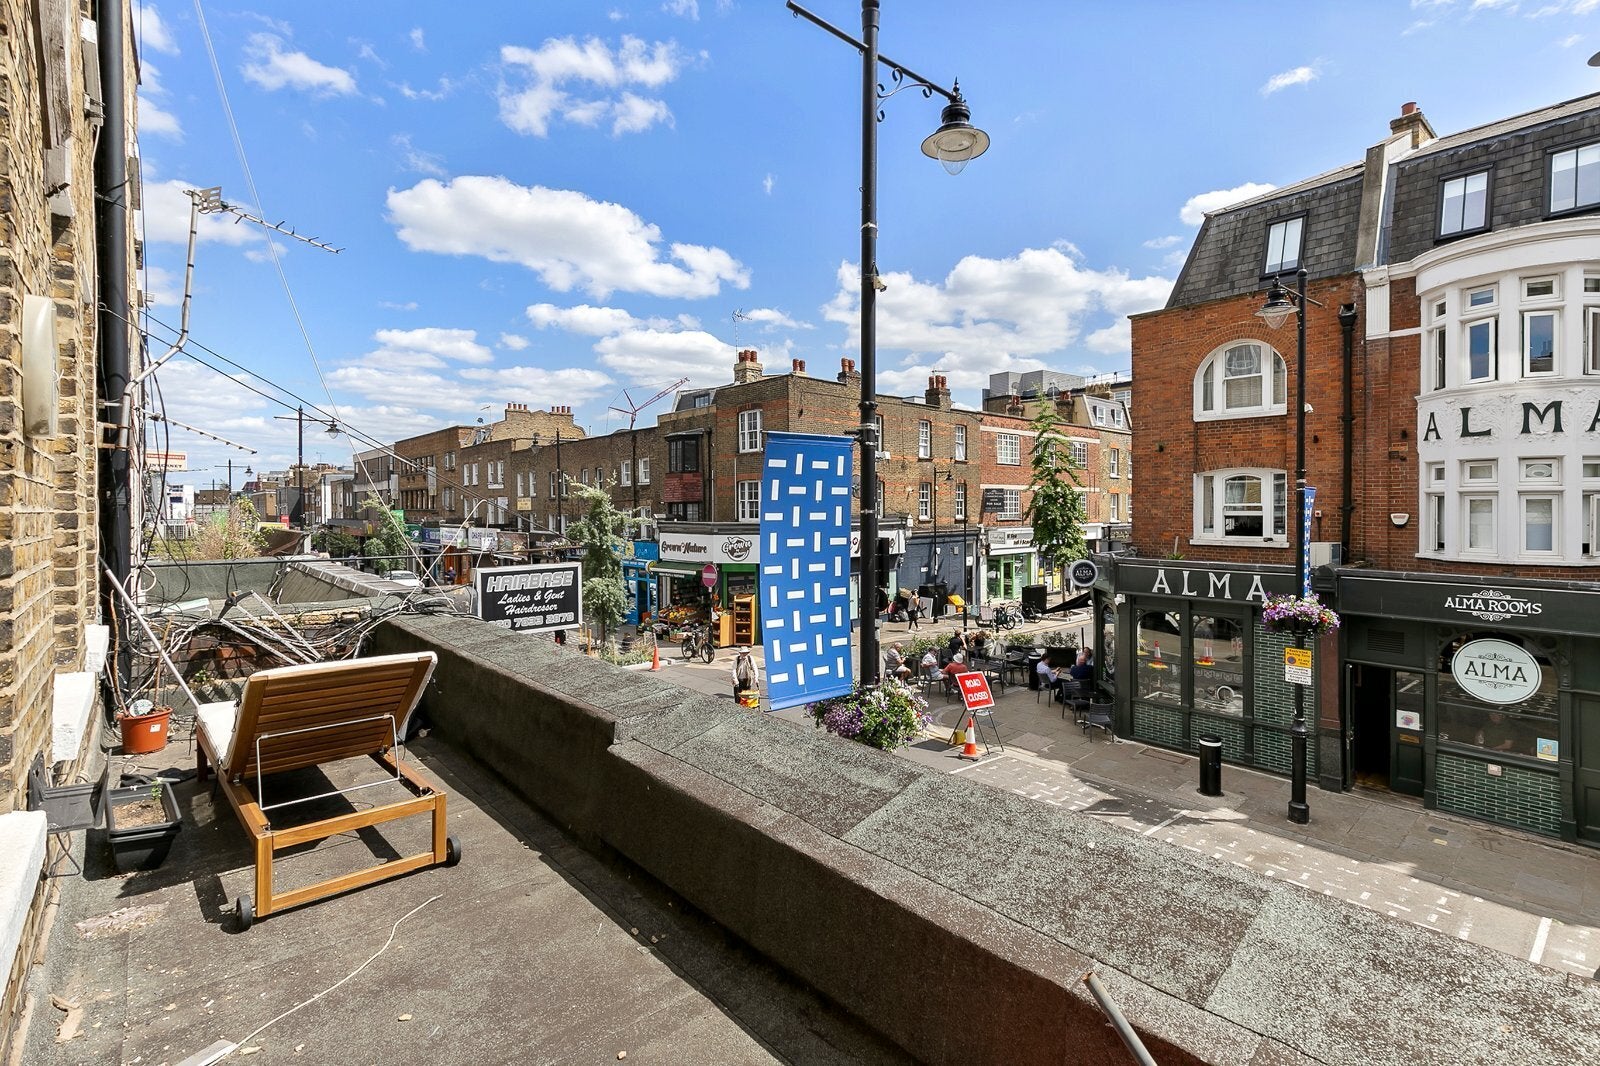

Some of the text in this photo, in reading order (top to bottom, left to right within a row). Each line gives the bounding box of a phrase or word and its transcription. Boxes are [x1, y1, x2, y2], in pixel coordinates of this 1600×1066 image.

[486, 570, 574, 593] HAIRBASE
[1151, 569, 1269, 602] ALMA
[497, 589, 565, 605] Ladies & Gent
[504, 604, 558, 616] Hairdresser
[1444, 597, 1542, 615] ALMA ROOMS
[487, 618, 512, 629] 20
[1464, 660, 1528, 683] ALMA
[965, 678, 981, 688] ROAD
[967, 691, 989, 702] CLOSED
